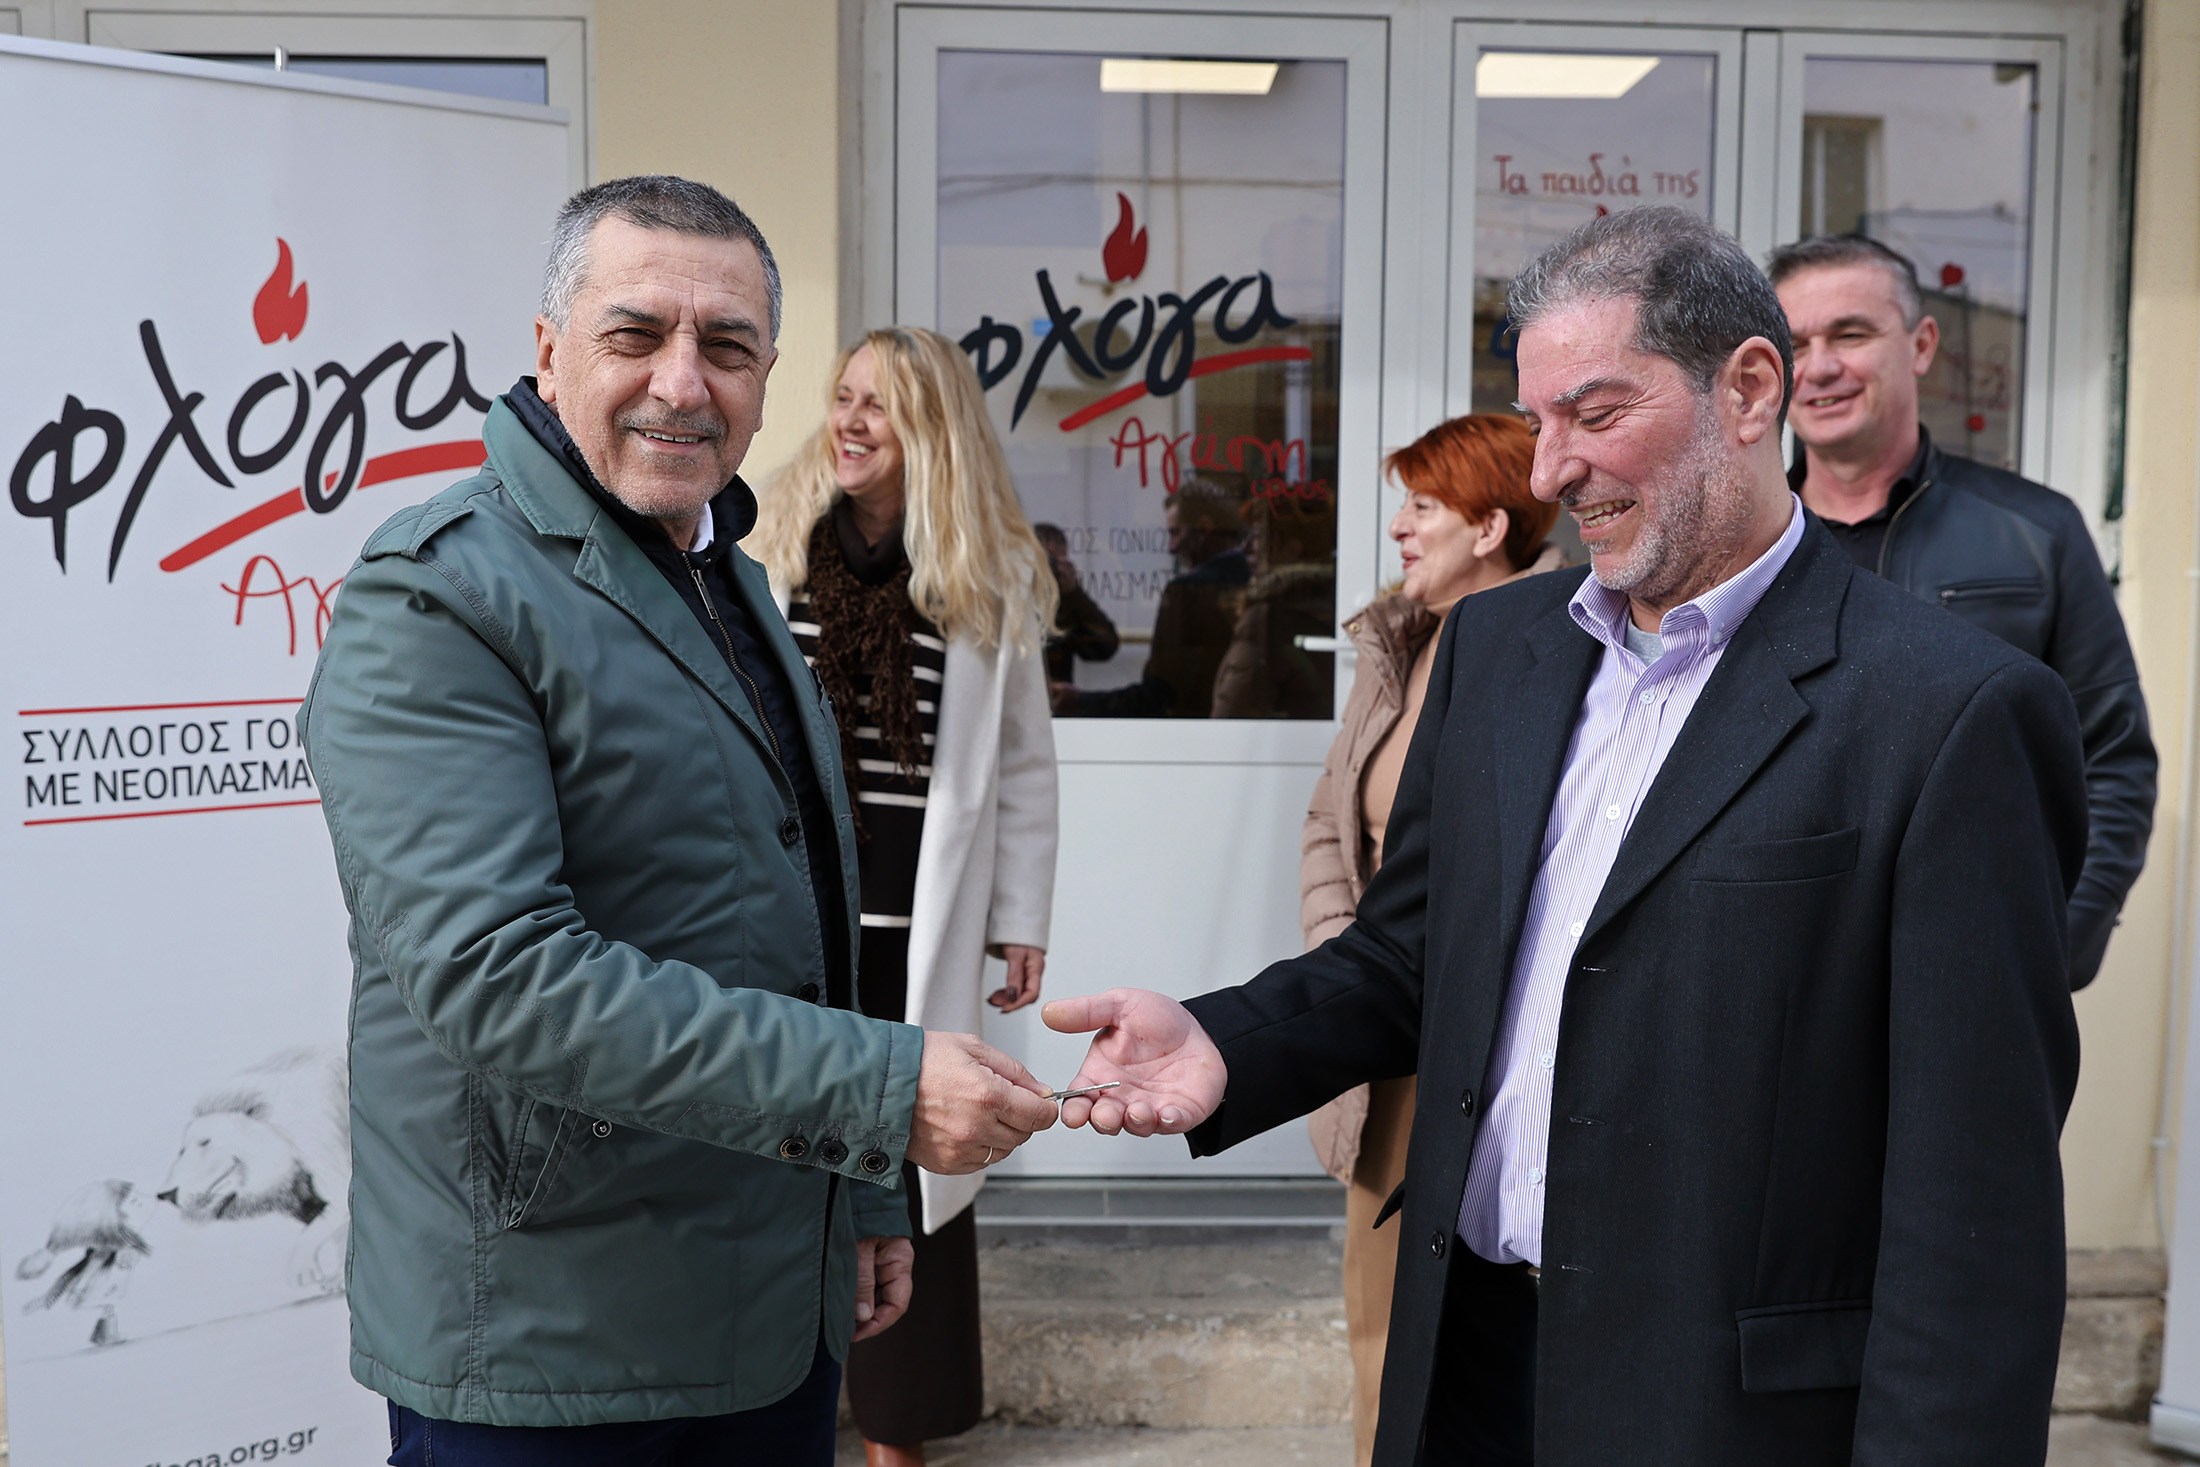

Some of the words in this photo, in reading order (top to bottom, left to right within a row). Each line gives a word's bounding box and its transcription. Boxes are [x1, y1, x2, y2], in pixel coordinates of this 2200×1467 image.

[1493, 154, 1530, 195] Τα
[1653, 168, 1700, 198] της
[22, 720, 230, 764] ΣΥΛΛΟΓΟΣ
[26, 773, 81, 808] ΜΕ
[95, 758, 312, 803] ΝΕΟΠΛΑΣΜΑ
[144, 1426, 318, 1467] a.org.gr
